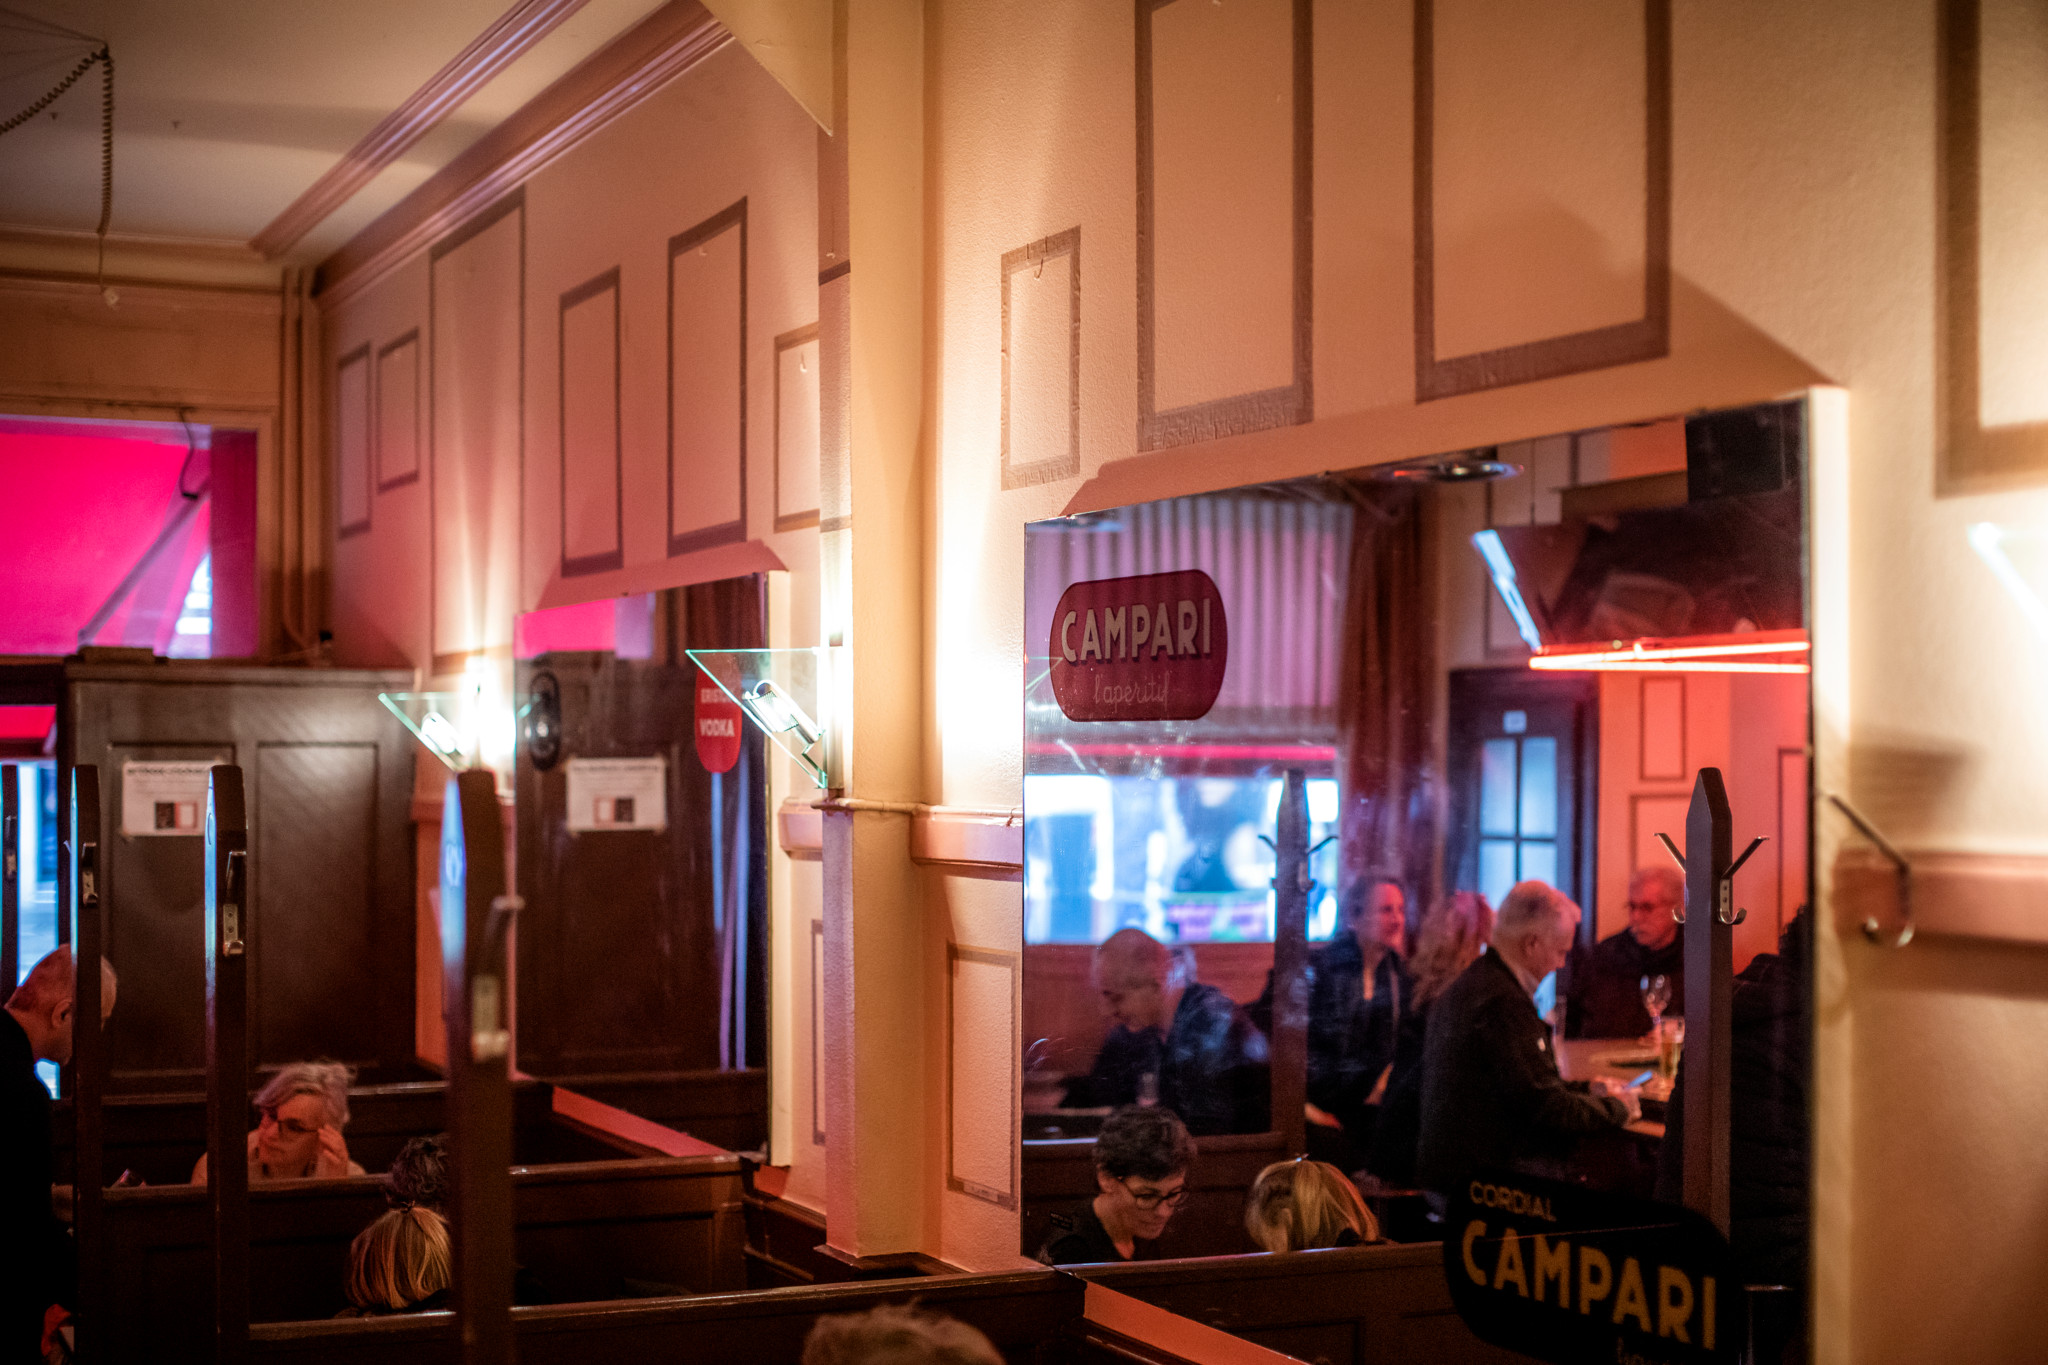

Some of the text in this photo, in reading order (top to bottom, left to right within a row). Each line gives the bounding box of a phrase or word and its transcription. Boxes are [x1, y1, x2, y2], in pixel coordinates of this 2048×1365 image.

[1061, 598, 1211, 663] CAMPARI
[699, 718, 735, 737] VODKA
[1469, 1181, 1557, 1222] CORDIAL
[1462, 1219, 1716, 1350] CAMPARI
